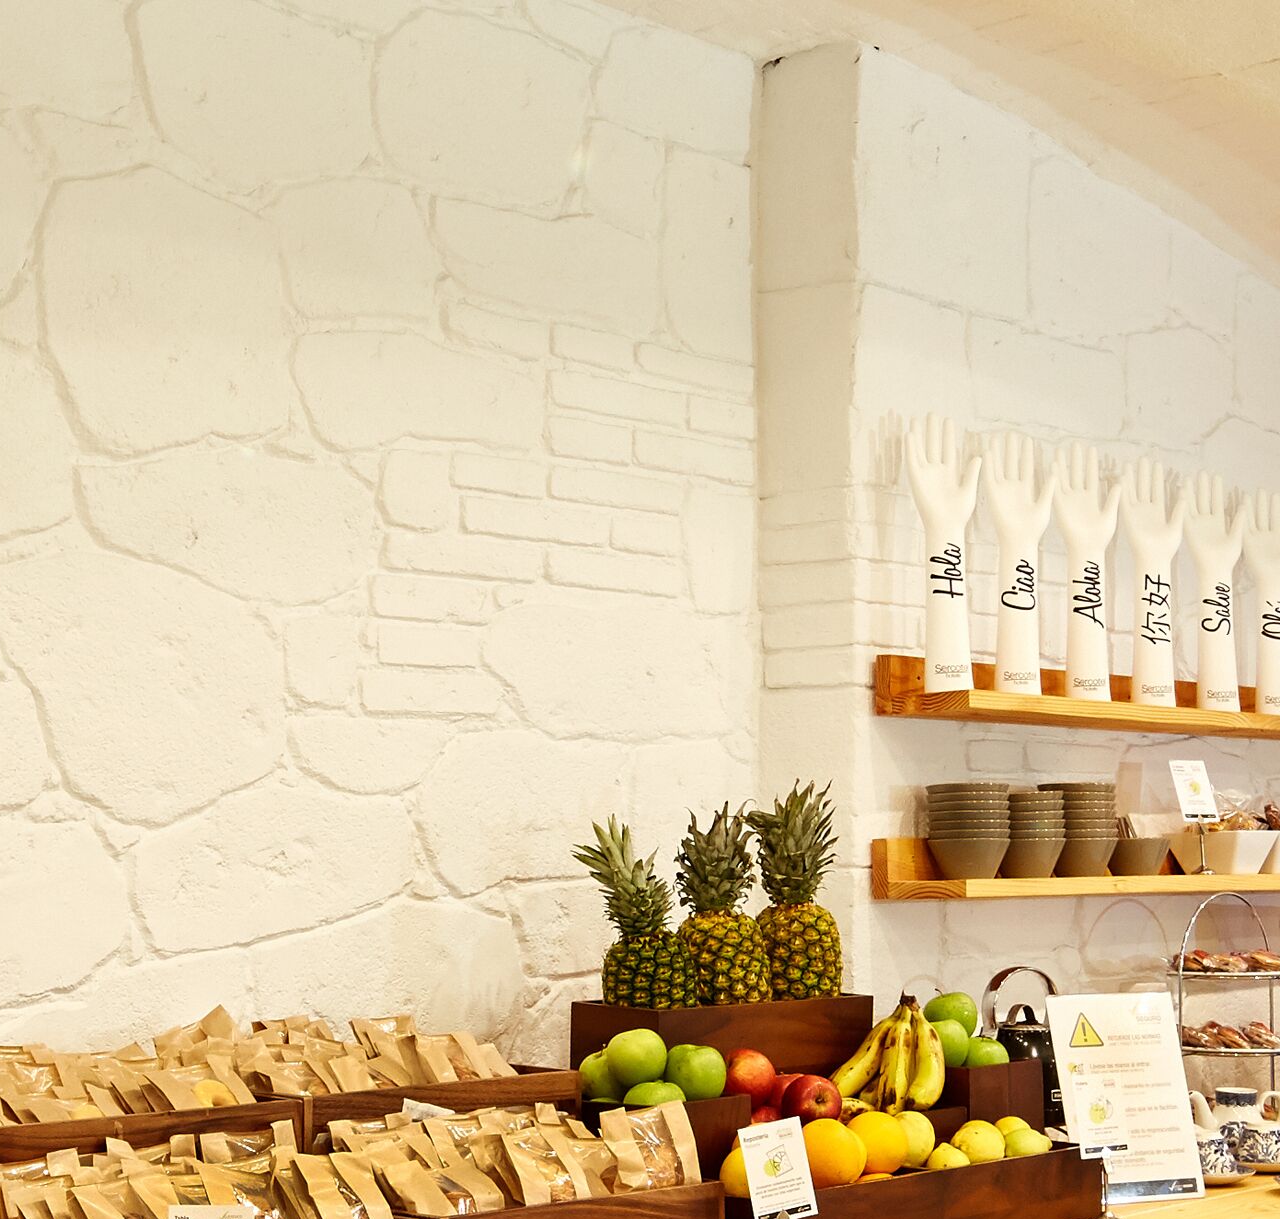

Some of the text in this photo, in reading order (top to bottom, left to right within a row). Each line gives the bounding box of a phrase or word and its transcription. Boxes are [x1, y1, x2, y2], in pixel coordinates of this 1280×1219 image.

[930, 543, 963, 598] Hola
[1001, 558, 1036, 610] Ciao
[1073, 561, 1104, 629] Aloha
[1141, 574, 1171, 644] 你好
[1201, 582, 1231, 635] Salve
